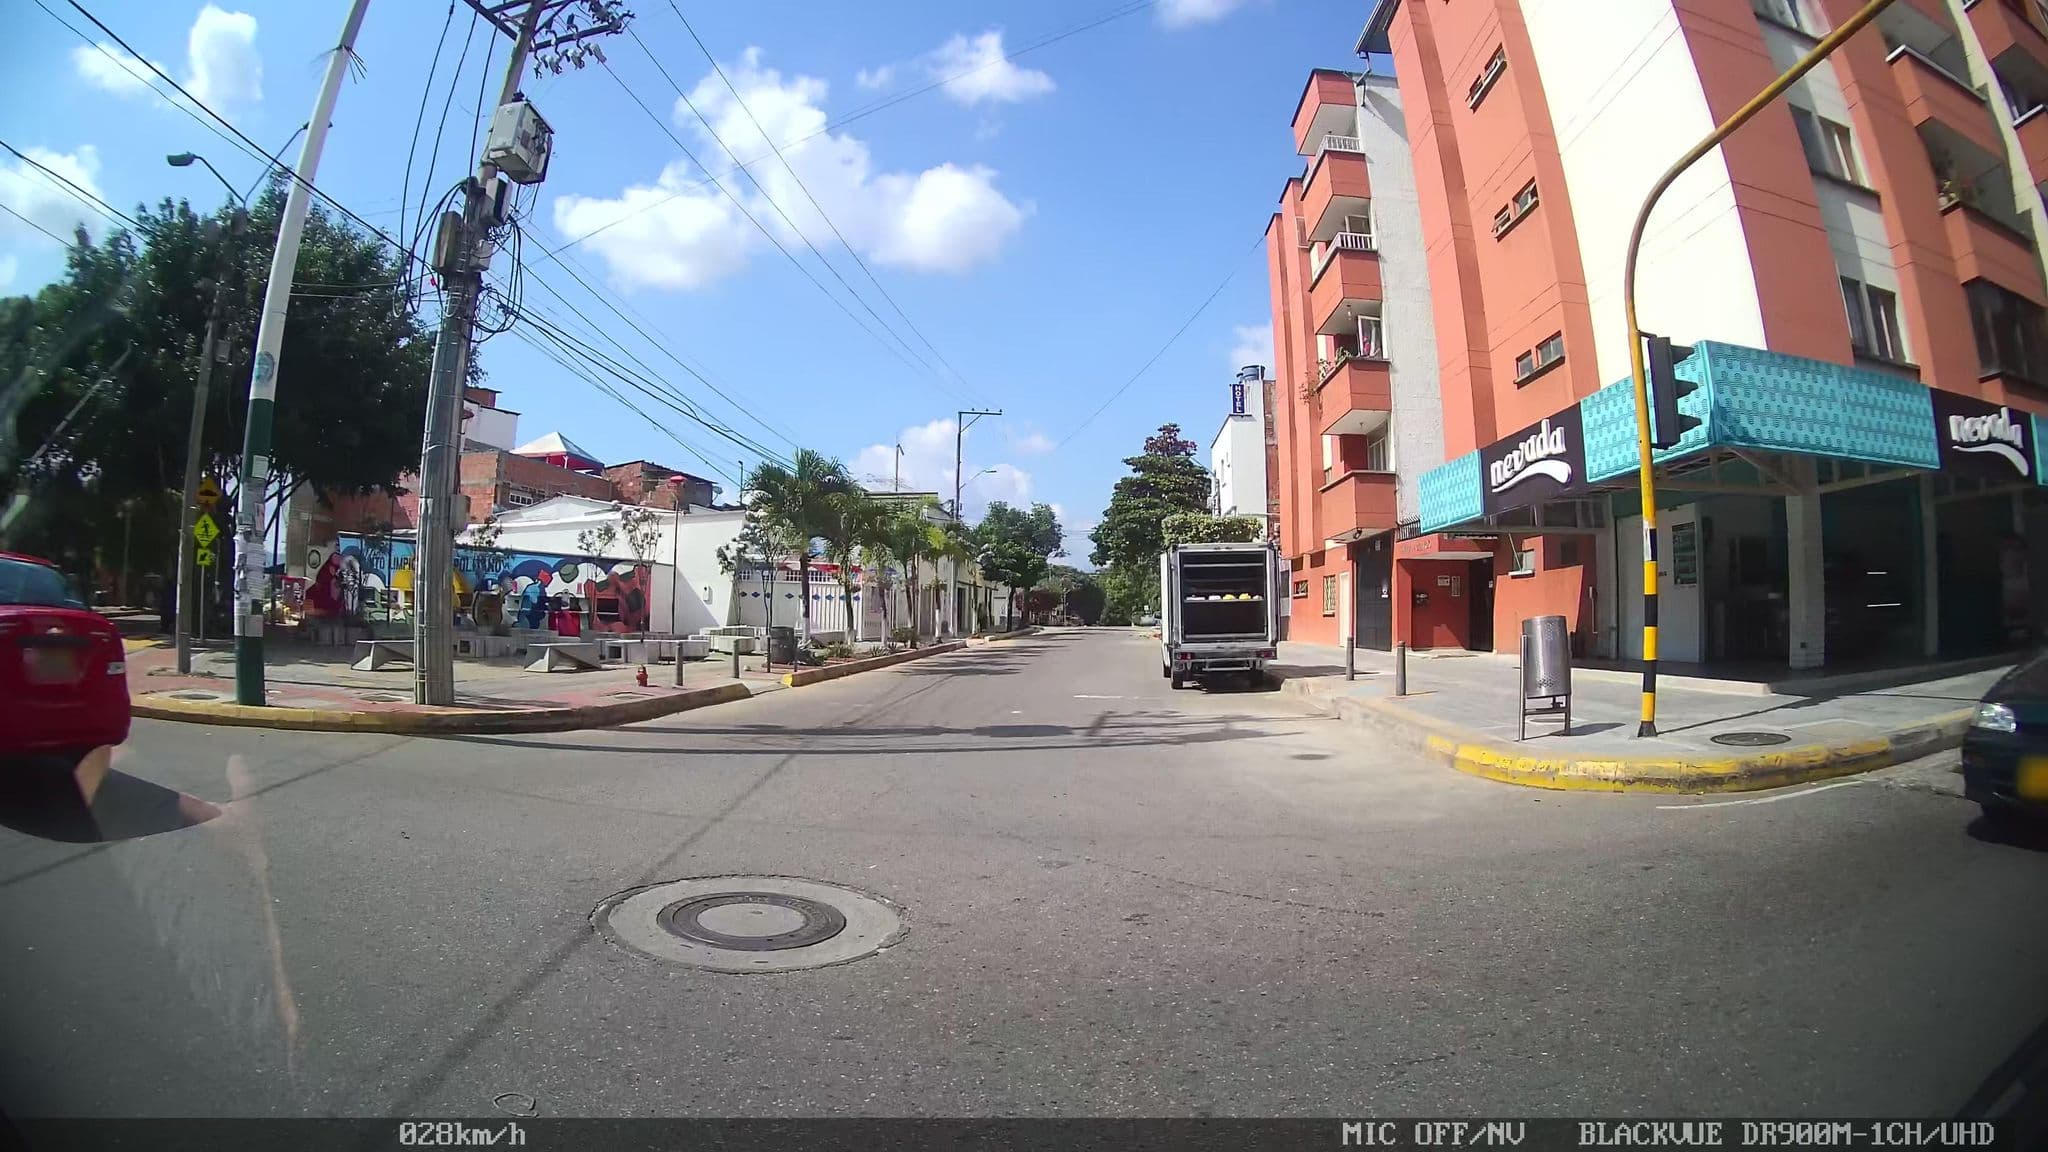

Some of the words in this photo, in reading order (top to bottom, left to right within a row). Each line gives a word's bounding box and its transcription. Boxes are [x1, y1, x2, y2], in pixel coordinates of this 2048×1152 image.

[1949, 406, 2024, 449] nevada
[1490, 418, 1567, 487] nevada
[453, 554, 502, 573] POLITANO
